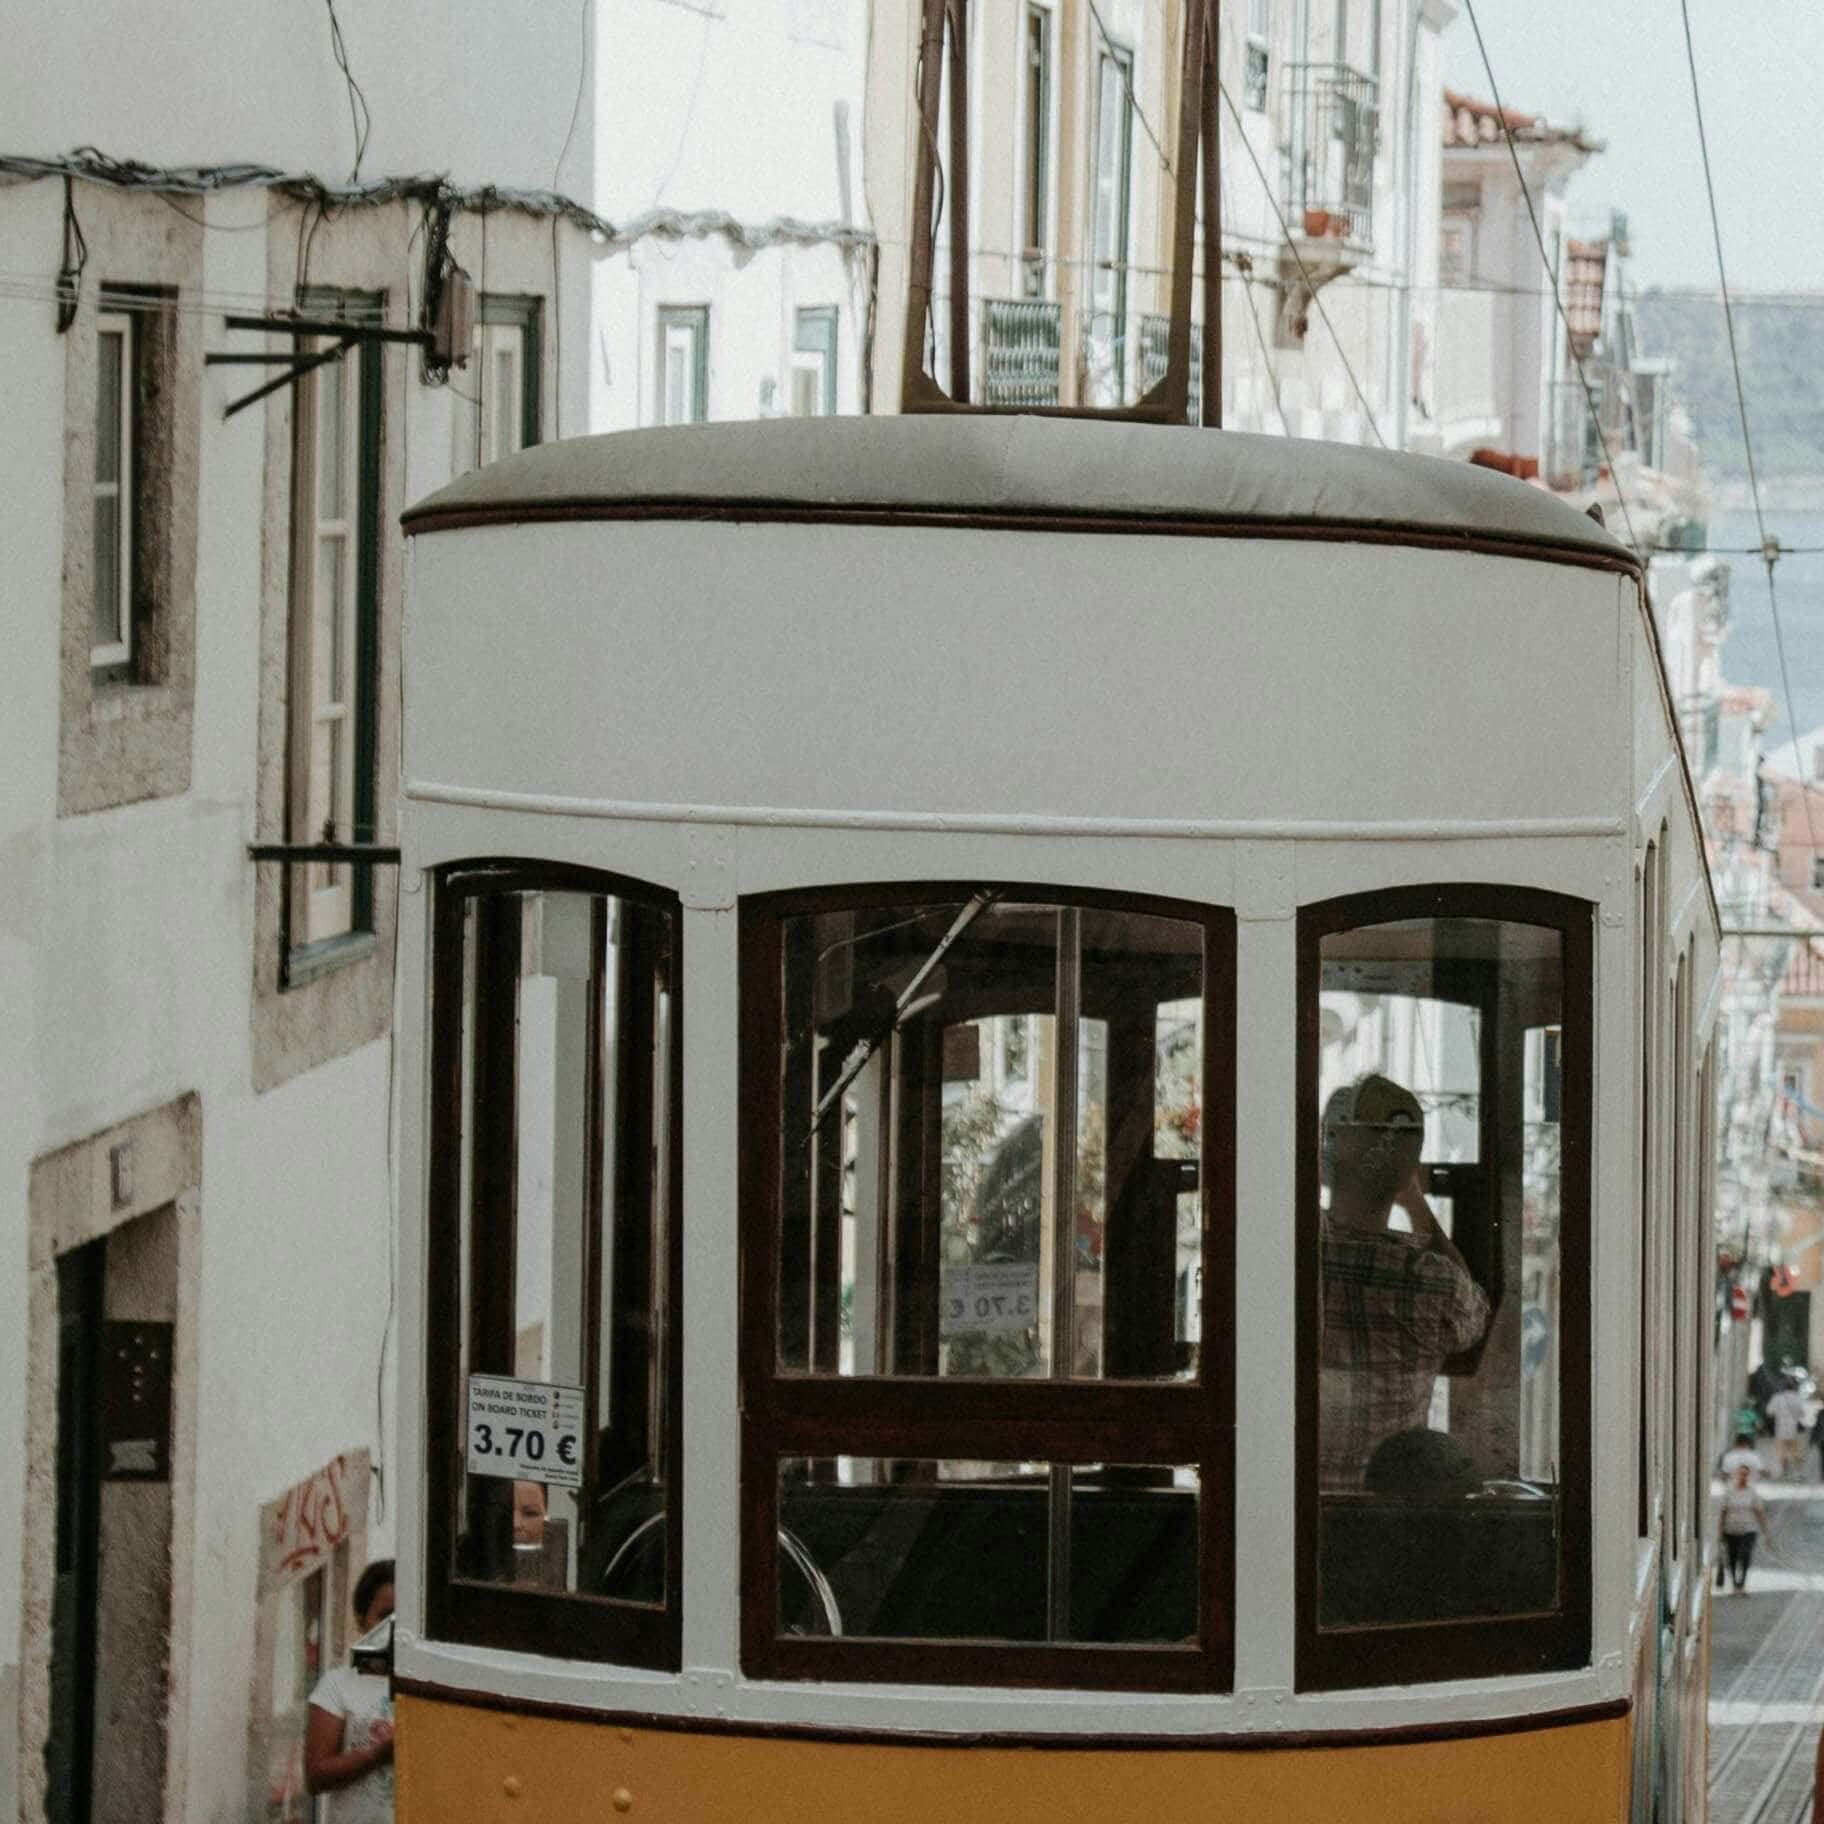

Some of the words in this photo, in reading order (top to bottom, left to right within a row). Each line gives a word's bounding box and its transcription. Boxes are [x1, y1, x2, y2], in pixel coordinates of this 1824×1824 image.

[472, 1387, 501, 1399] TARIFA
[503, 1391, 514, 1400] DE
[516, 1393, 547, 1405] BORDO
[472, 1402, 485, 1411] ON
[487, 1404, 517, 1416] BOARD
[519, 1407, 547, 1419] TICKET
[473, 1423, 545, 1461] 3.70
[556, 1434, 577, 1466] €
